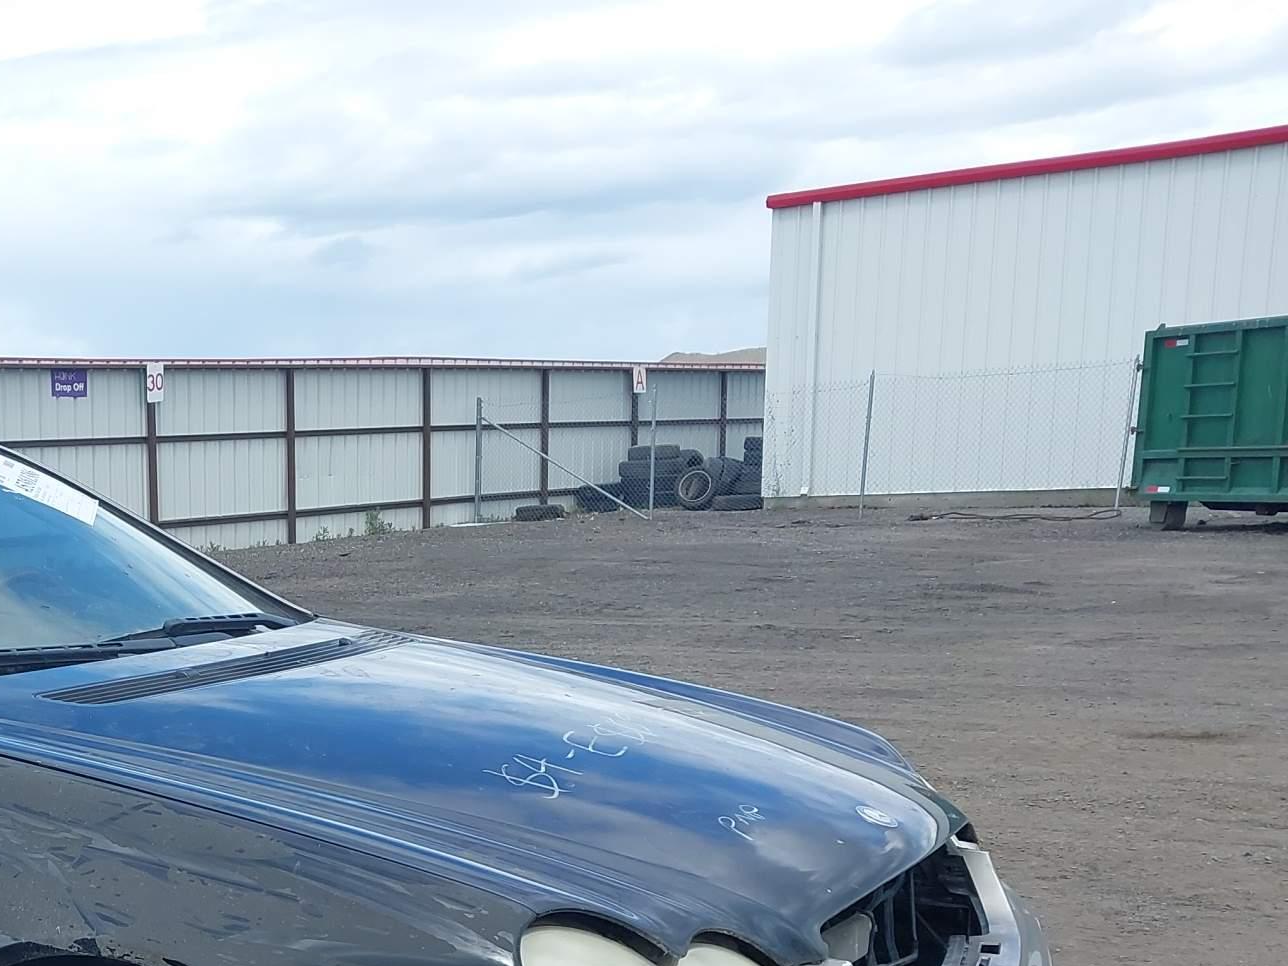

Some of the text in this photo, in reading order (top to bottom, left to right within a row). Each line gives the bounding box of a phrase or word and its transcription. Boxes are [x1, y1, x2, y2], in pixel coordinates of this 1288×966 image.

[55, 382, 85, 393] Drop Off
[146, 372, 164, 392] 30
[635, 370, 645, 391] A
